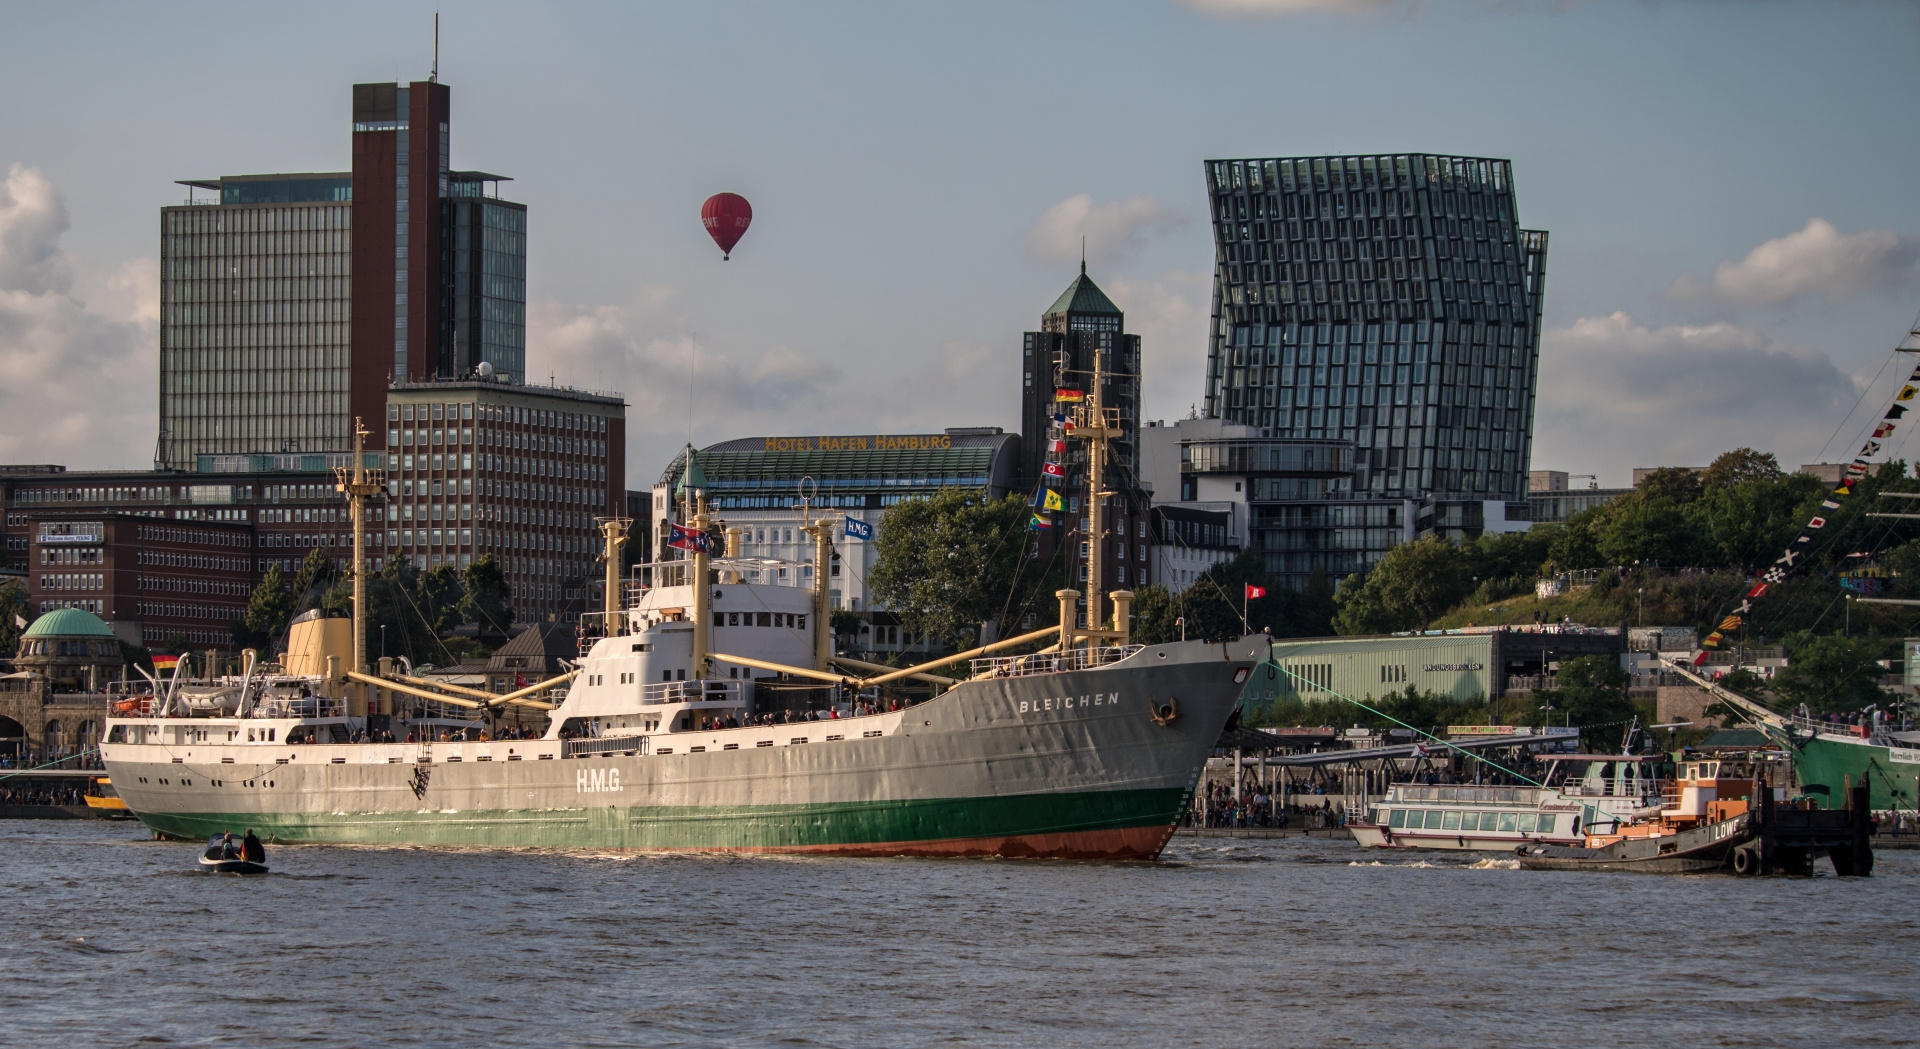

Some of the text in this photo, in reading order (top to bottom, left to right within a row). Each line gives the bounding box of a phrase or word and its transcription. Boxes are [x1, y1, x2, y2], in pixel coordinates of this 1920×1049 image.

[765, 435, 951, 451] HOTEL HAFEN HAMBURG
[1020, 693, 1119, 713] BLEICHEN
[1891, 751, 1913, 761] Herzlich
[576, 768, 624, 793] H.M.G.
